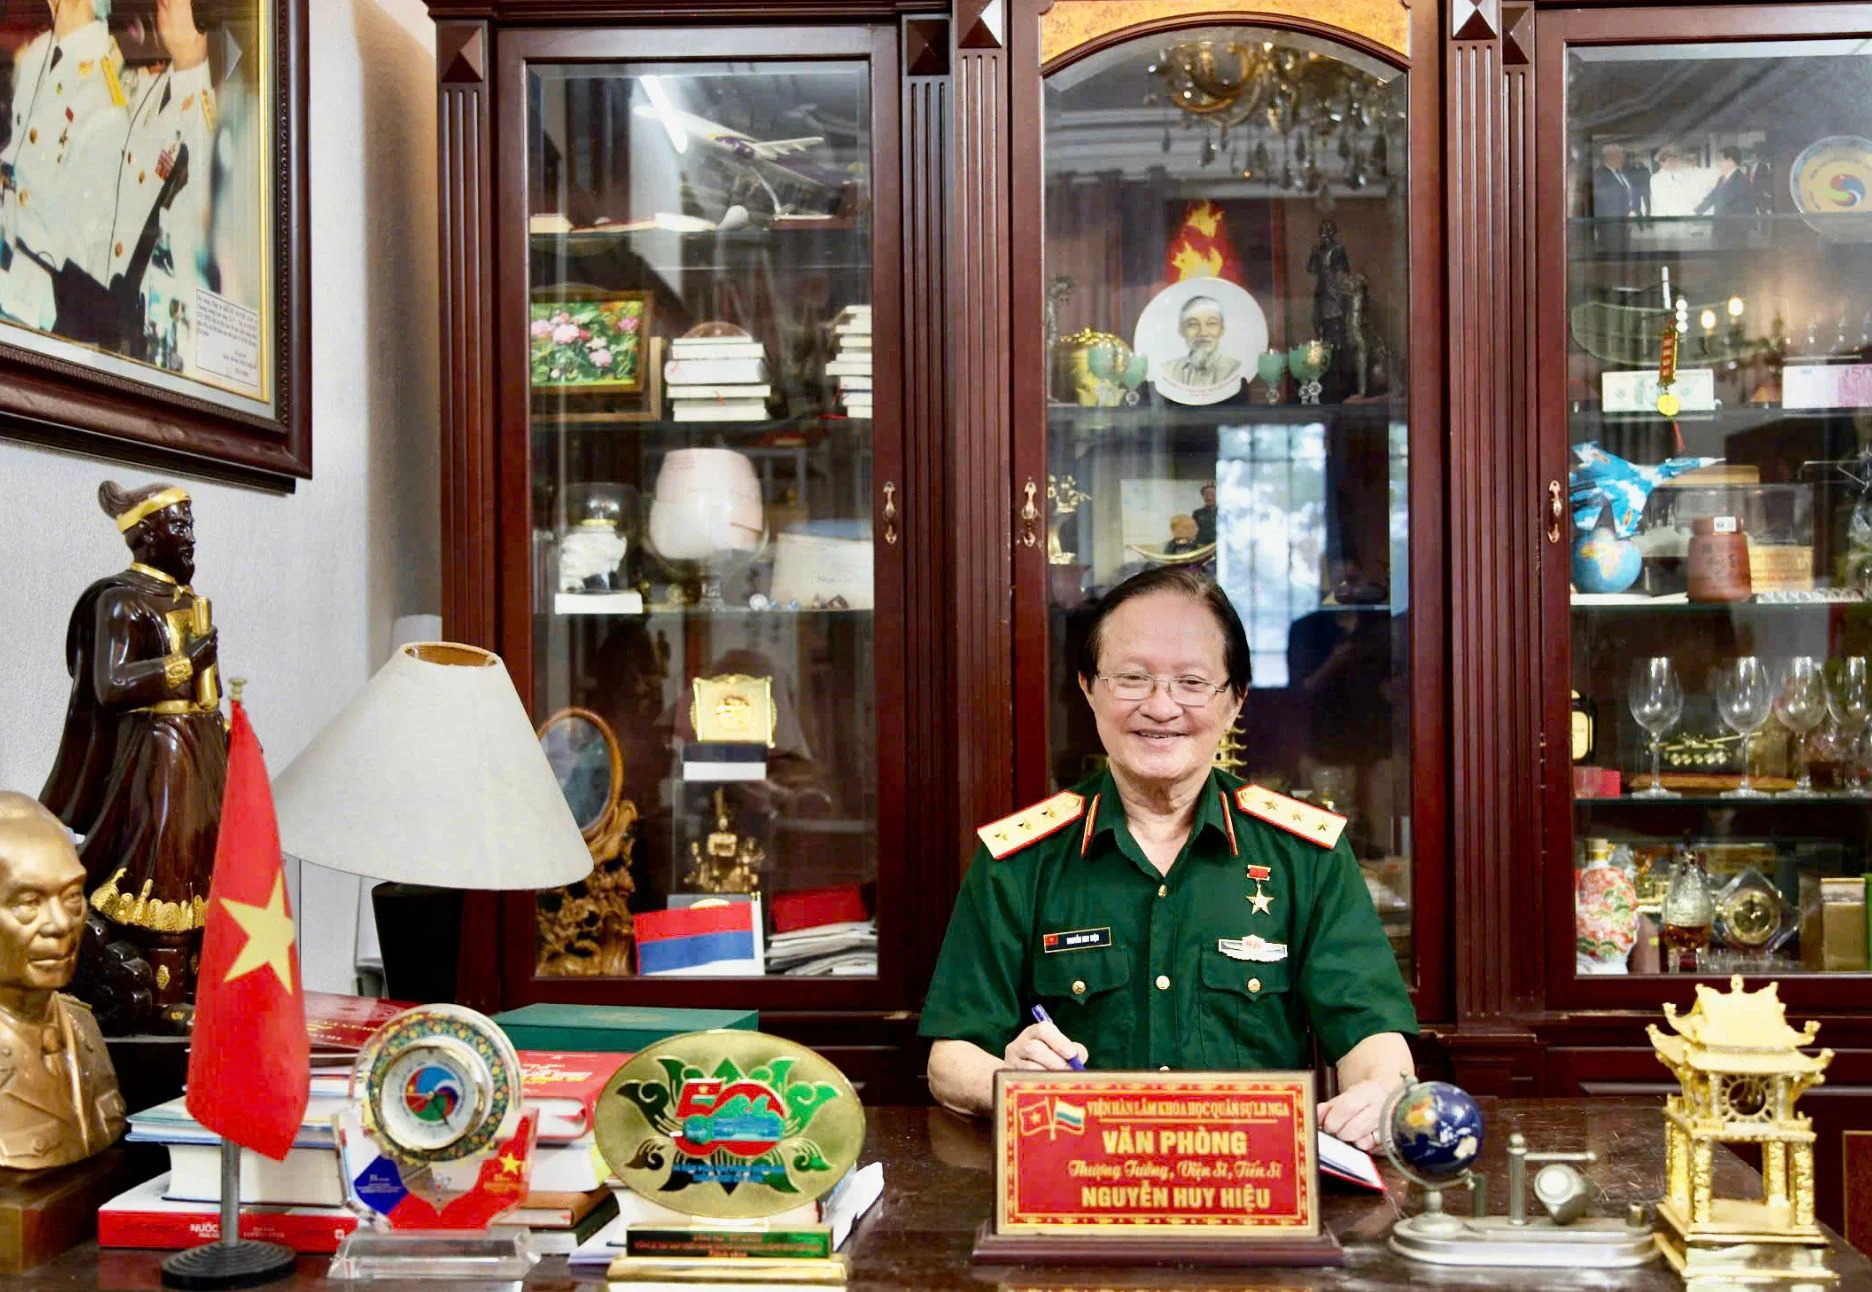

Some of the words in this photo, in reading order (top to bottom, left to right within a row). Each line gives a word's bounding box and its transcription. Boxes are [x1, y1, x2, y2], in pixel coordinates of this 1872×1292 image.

[1158, 1101, 1187, 1116] KHOA
[1102, 1126, 1154, 1154] VĂN
[1160, 1126, 1247, 1155] PHÒNG
[1081, 1180, 1169, 1208] NGUYỄN
[1173, 1187, 1216, 1208] HUY
[1220, 1184, 1271, 1213] HIỆU
